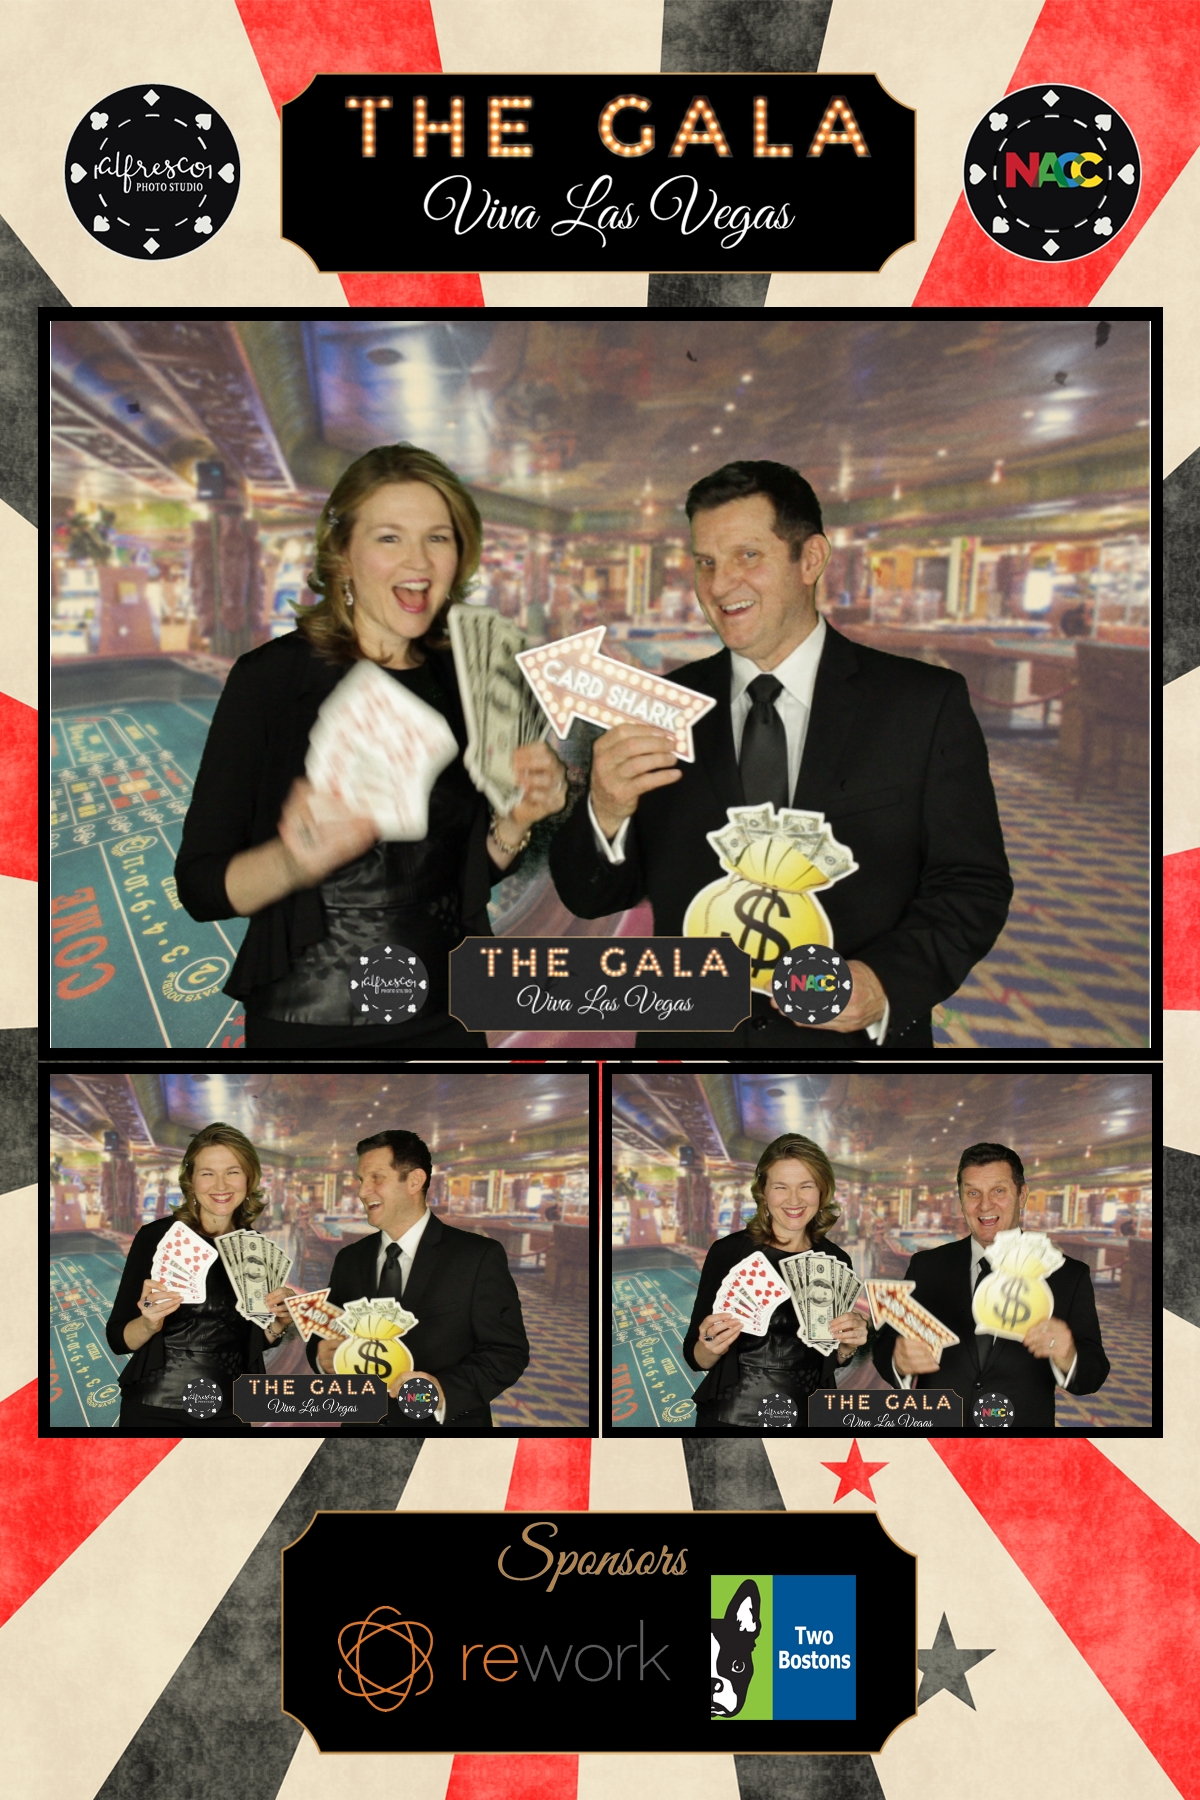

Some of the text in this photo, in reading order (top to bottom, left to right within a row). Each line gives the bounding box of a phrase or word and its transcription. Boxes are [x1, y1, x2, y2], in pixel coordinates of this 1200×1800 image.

[543, 660, 684, 731] CARD SHARK
[51, 886, 116, 1000] COME
[297, 1303, 329, 1325] CARD
